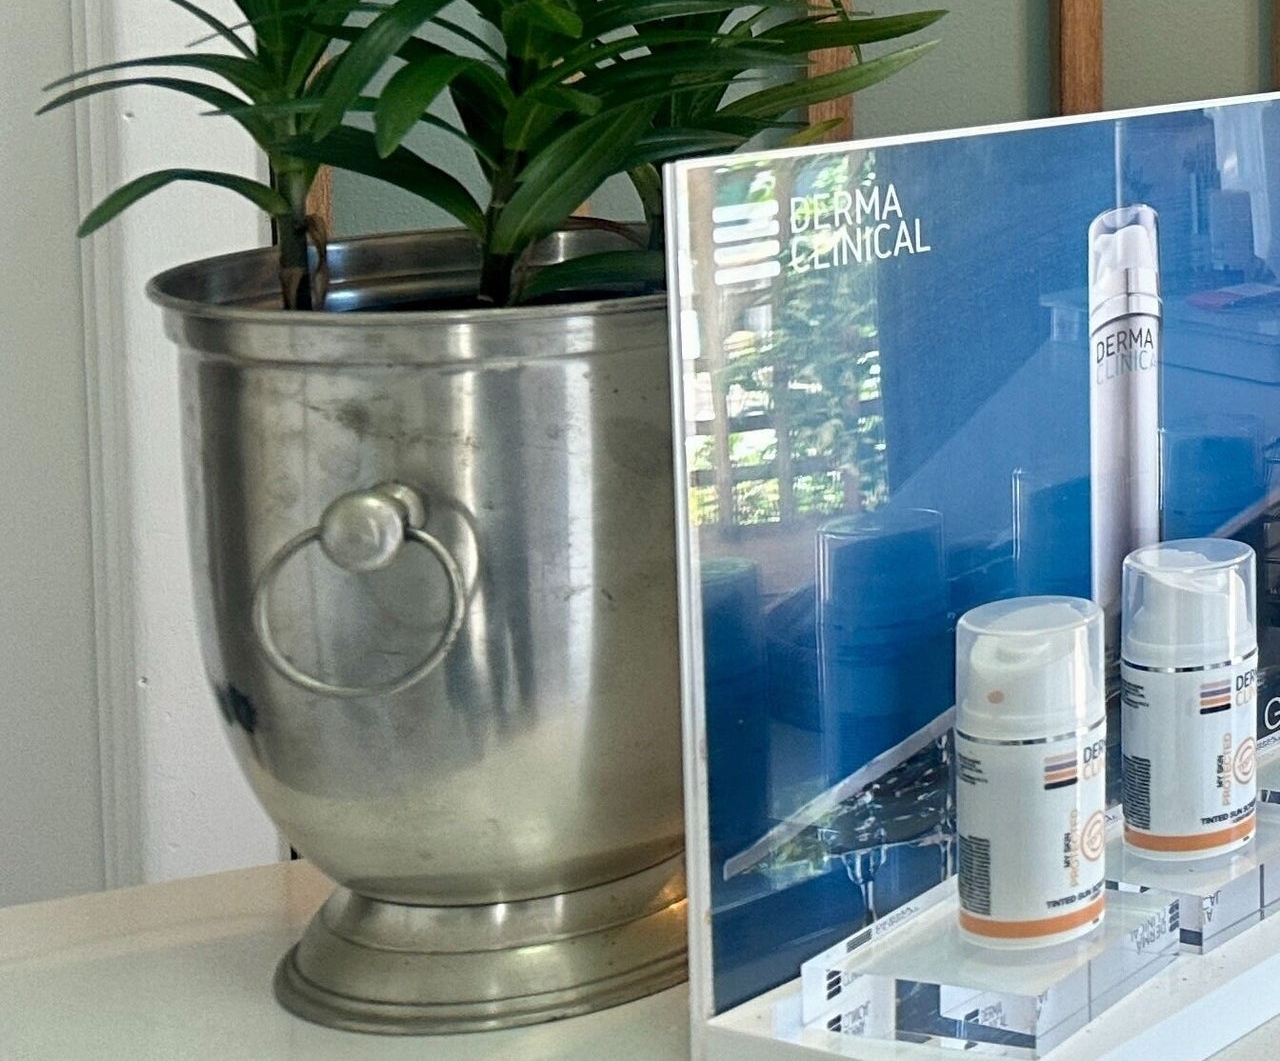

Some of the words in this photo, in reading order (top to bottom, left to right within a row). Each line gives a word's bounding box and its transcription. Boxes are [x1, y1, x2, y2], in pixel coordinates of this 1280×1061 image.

[790, 183, 903, 234] DERMA
[790, 218, 931, 274] CLINICAL
[1096, 327, 1154, 364] DERMA
